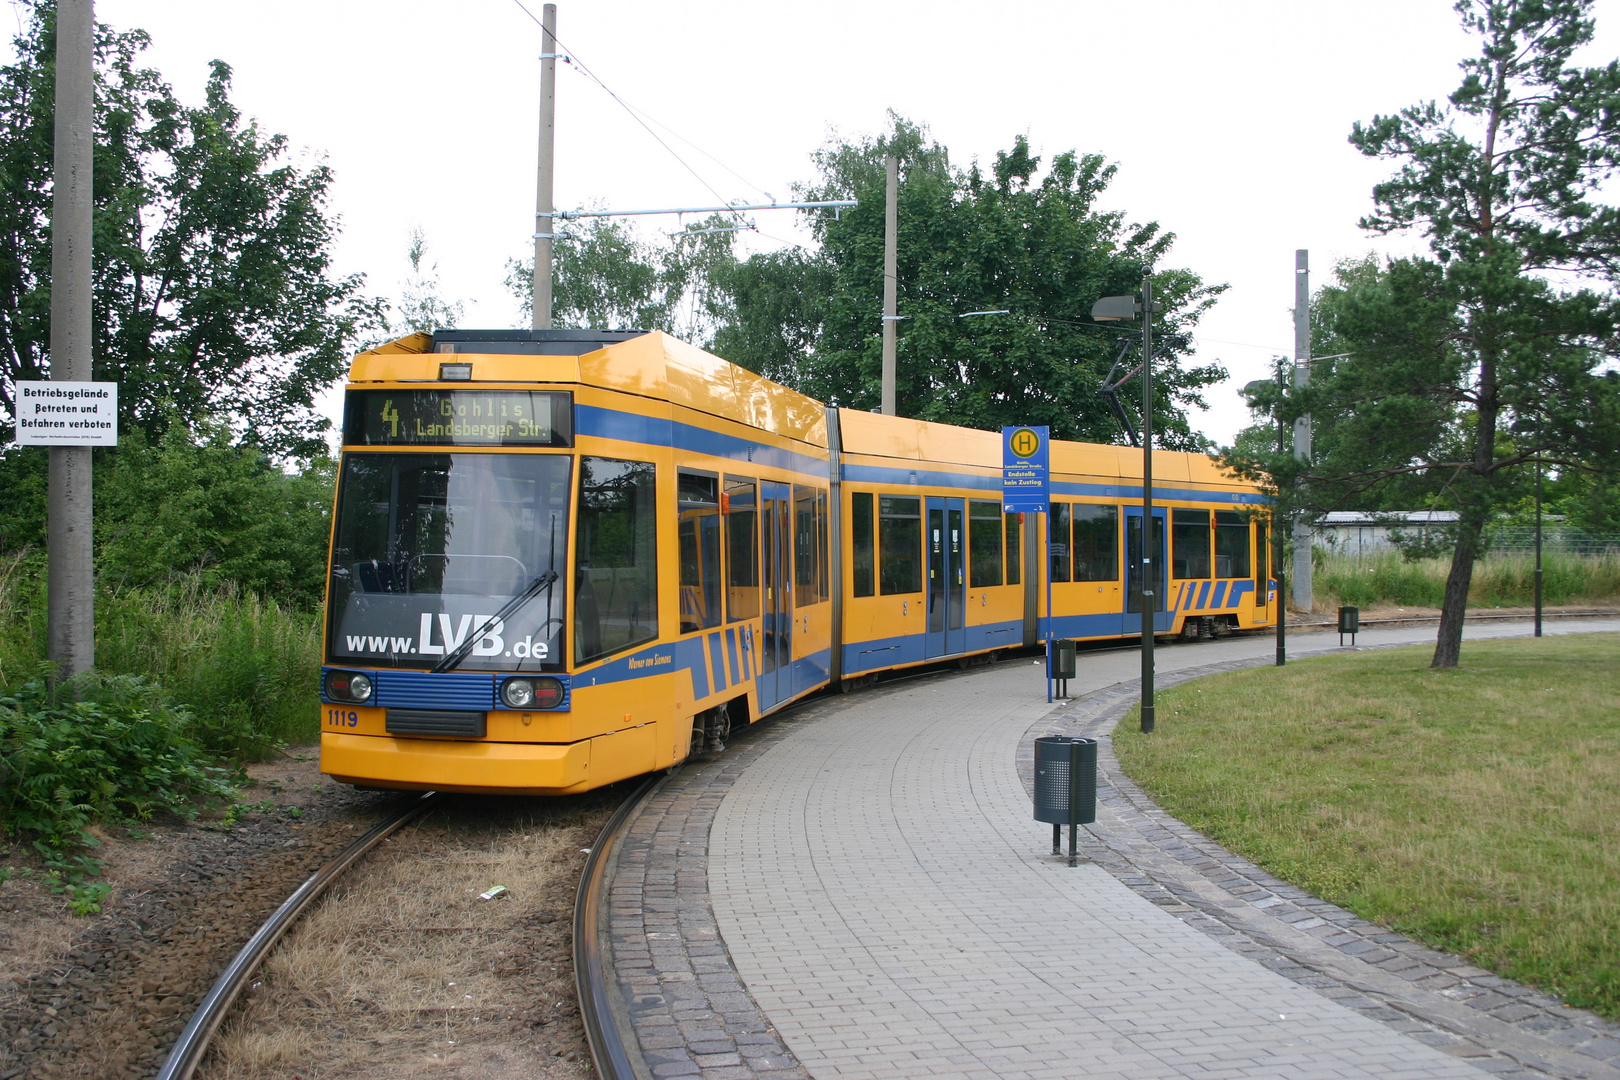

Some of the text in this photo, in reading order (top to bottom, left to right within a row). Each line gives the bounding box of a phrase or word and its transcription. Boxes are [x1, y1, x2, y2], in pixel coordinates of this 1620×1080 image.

[24, 388, 109, 400] Betriebsgelände
[35, 403, 98, 413] Betreten und
[440, 399, 523, 417] Gohlis
[21, 418, 111, 429] Befahren verboten
[381, 399, 399, 437] 4
[416, 418, 546, 438] Landsberger Str.
[1019, 435, 1030, 451] H
[346, 613, 549, 659] www.LVB.de
[327, 709, 359, 728] 1119
